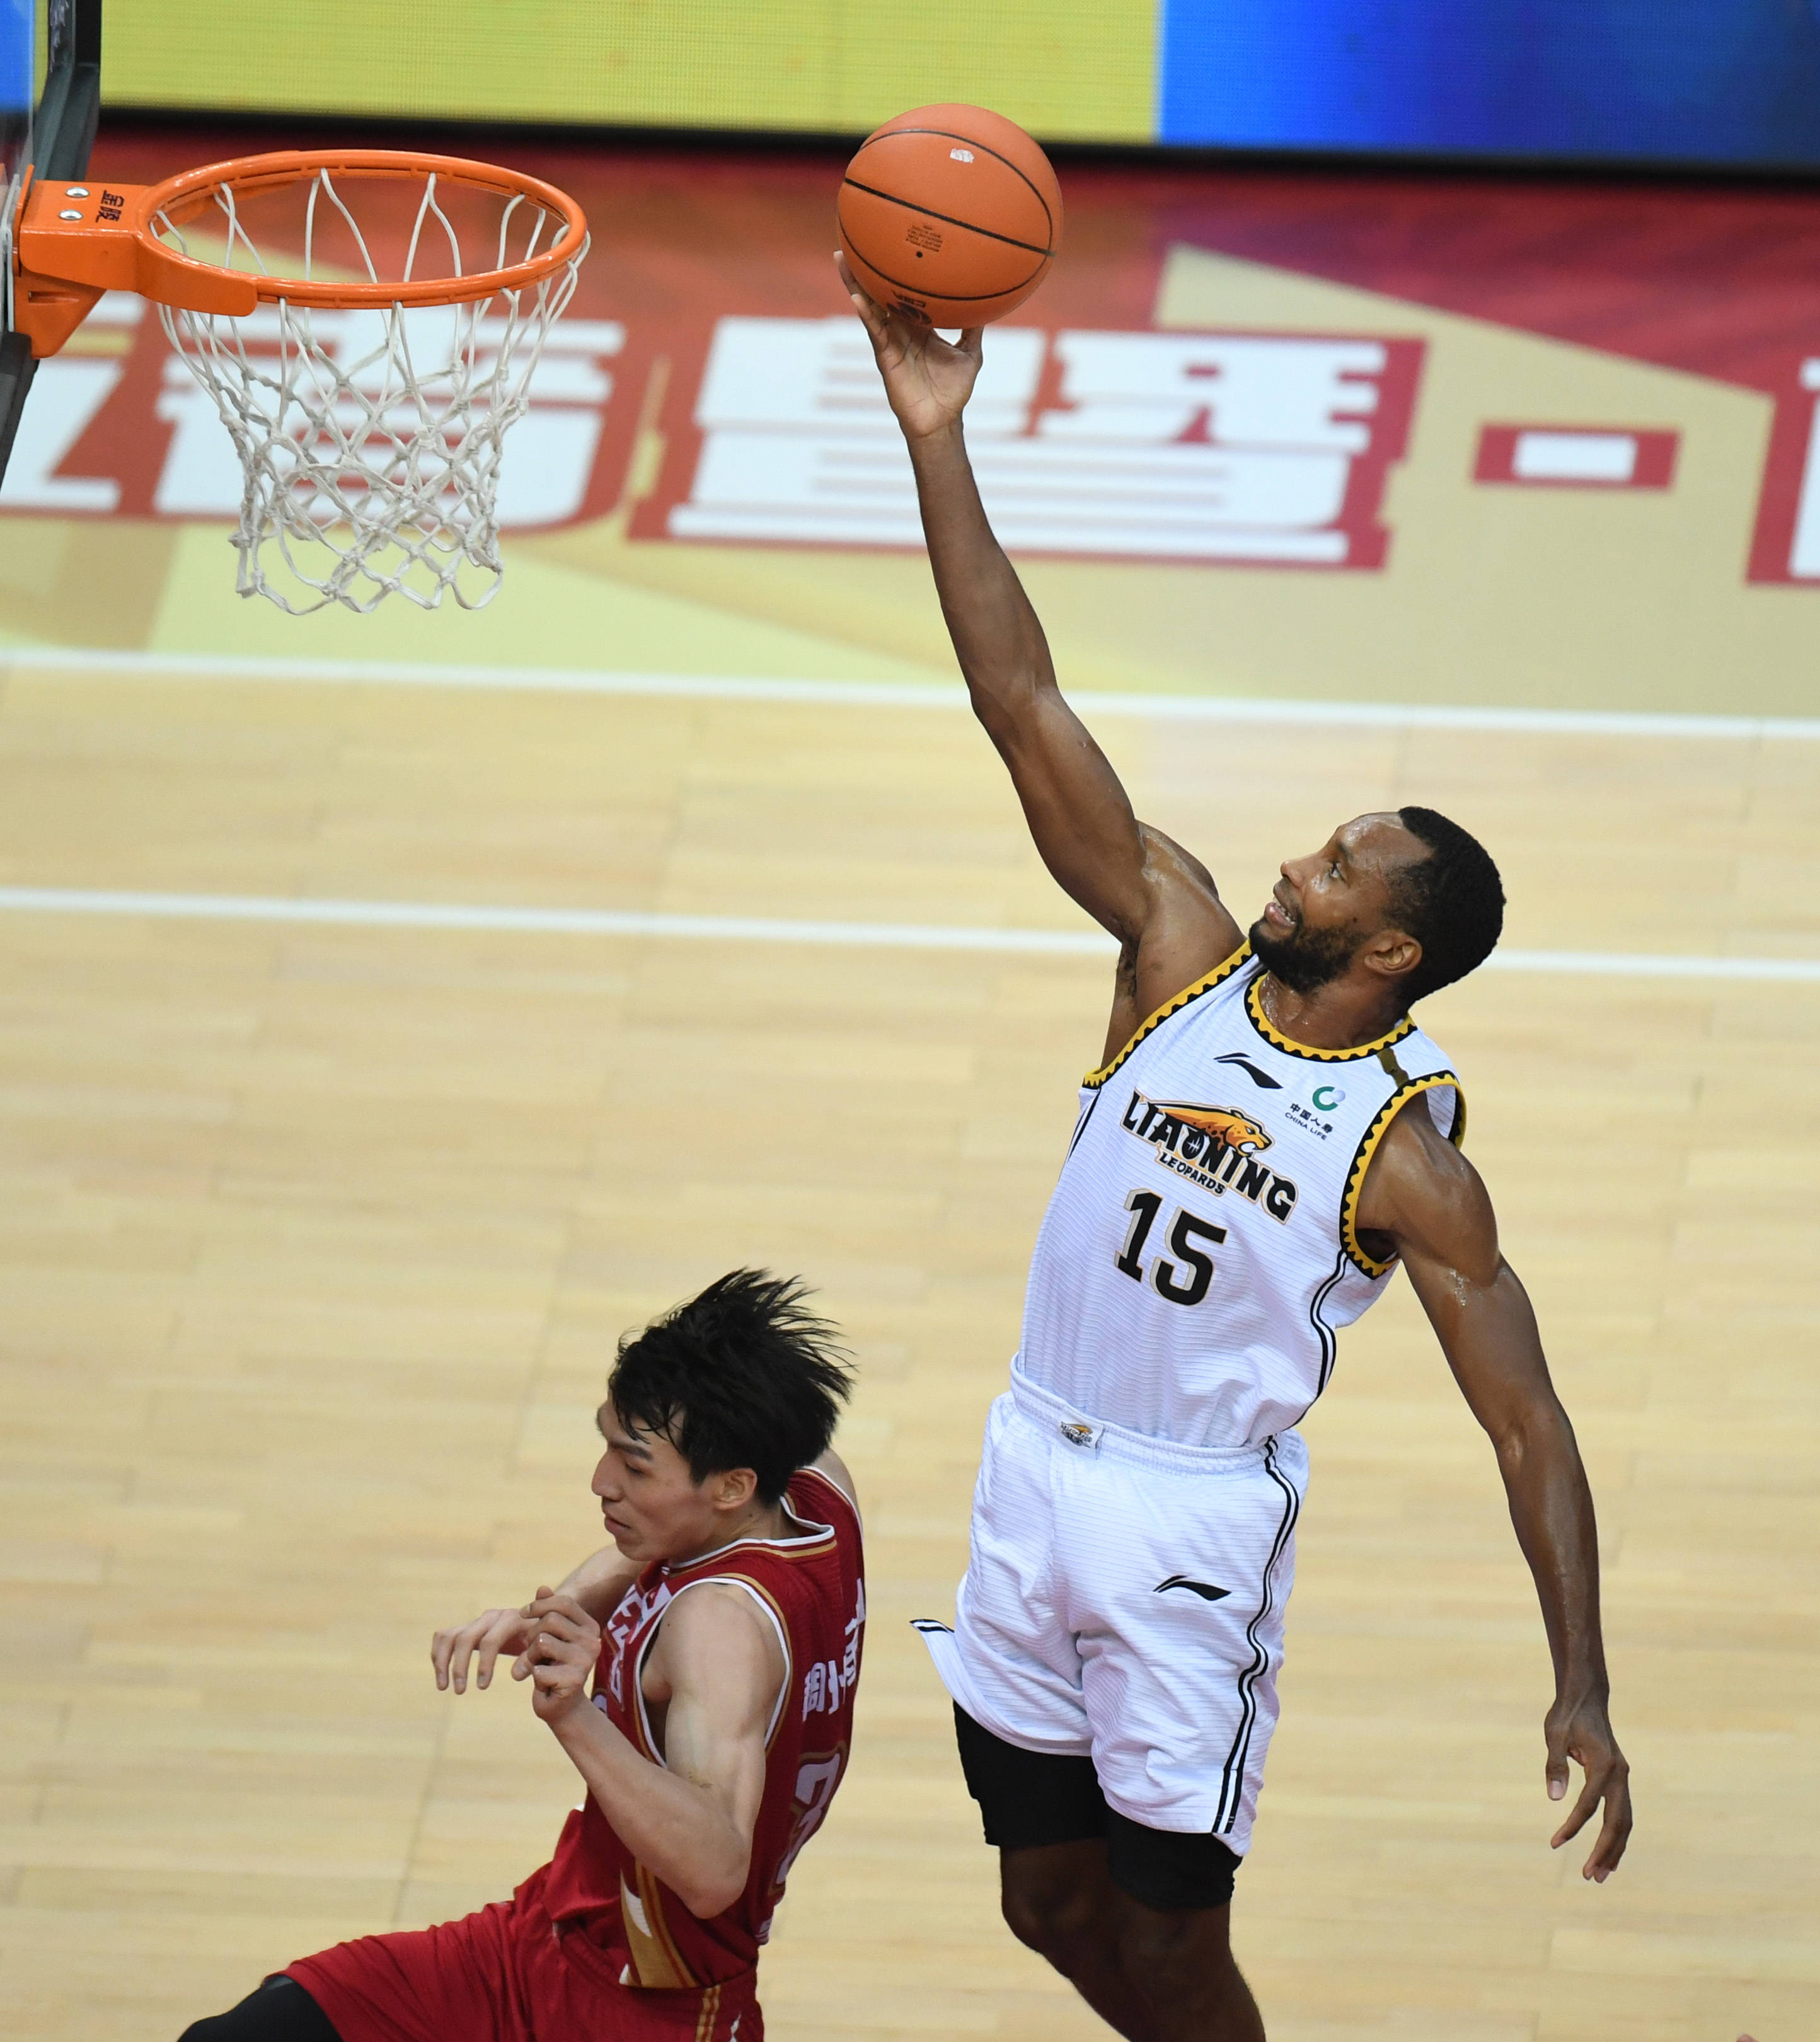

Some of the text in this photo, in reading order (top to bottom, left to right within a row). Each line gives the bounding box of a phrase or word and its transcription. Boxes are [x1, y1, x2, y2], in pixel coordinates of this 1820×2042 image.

[95, 190, 125, 223] 金陵
[1284, 1112, 1328, 1141] CHINA LIFE
[1122, 1089, 1297, 1223] LIAONING
[1159, 1153, 1226, 1195] LEOPARDS
[1115, 1188, 1227, 1305] 15
